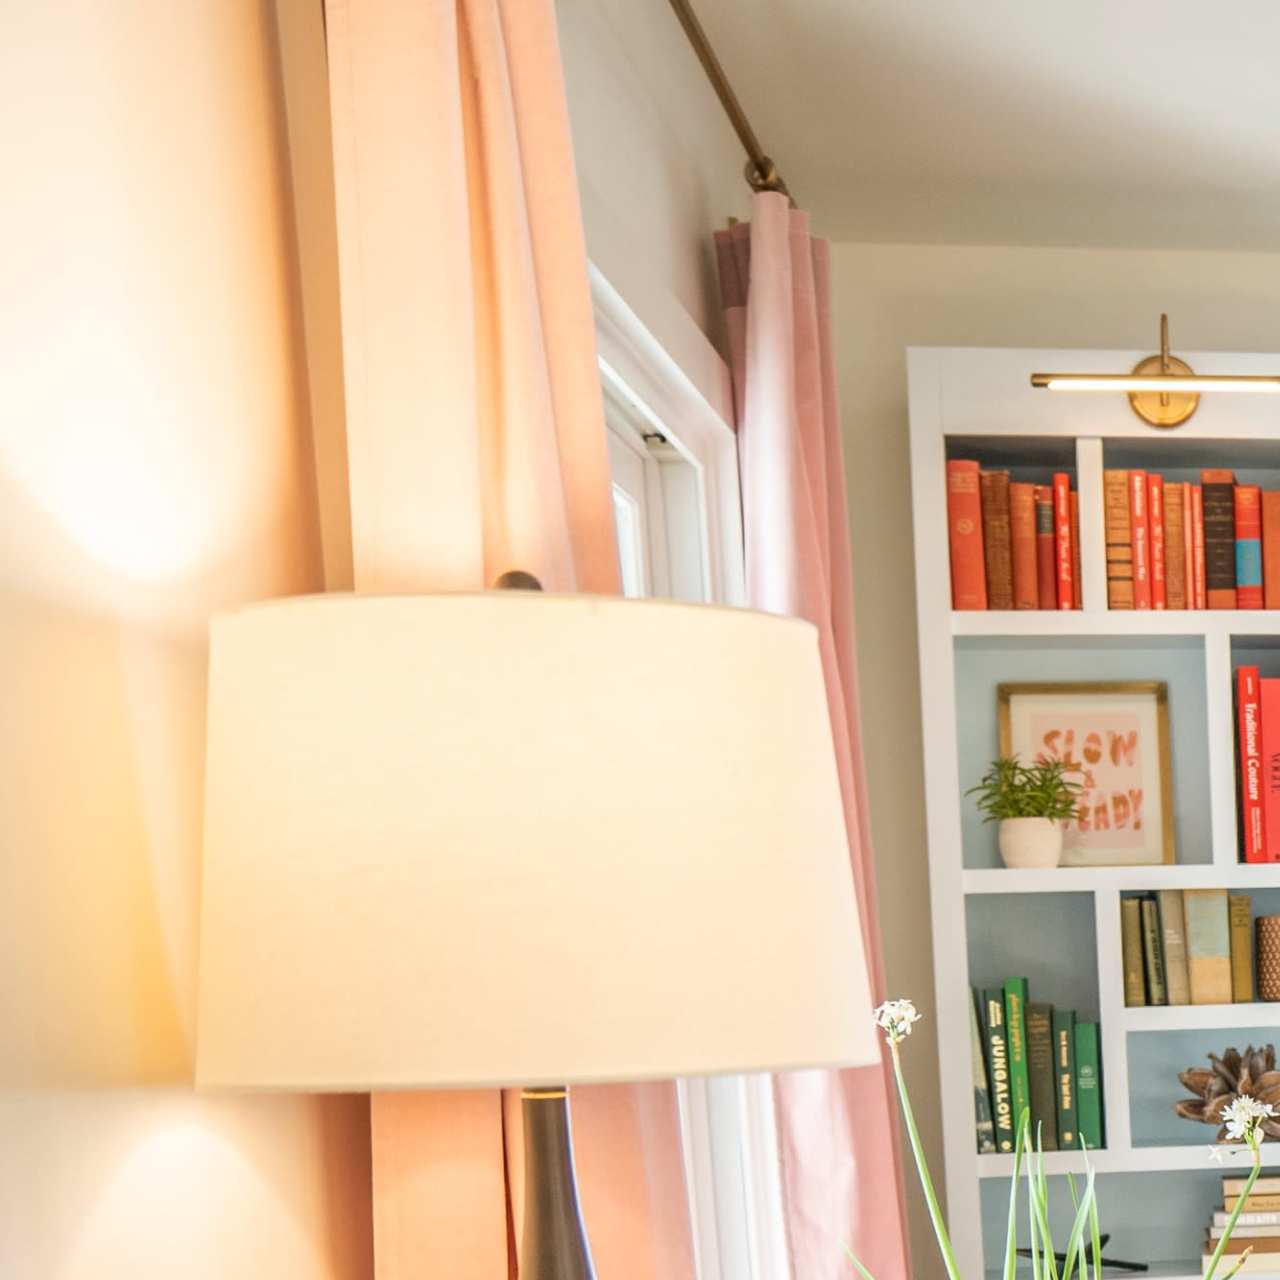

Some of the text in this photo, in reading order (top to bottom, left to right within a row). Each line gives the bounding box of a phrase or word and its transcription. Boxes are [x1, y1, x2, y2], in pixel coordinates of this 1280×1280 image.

[1034, 729, 1137, 772] SLOW
[1244, 703, 1259, 758] Traditional
[1247, 759, 1260, 800] Couture
[991, 1035, 1010, 1130] JUNGALOW
